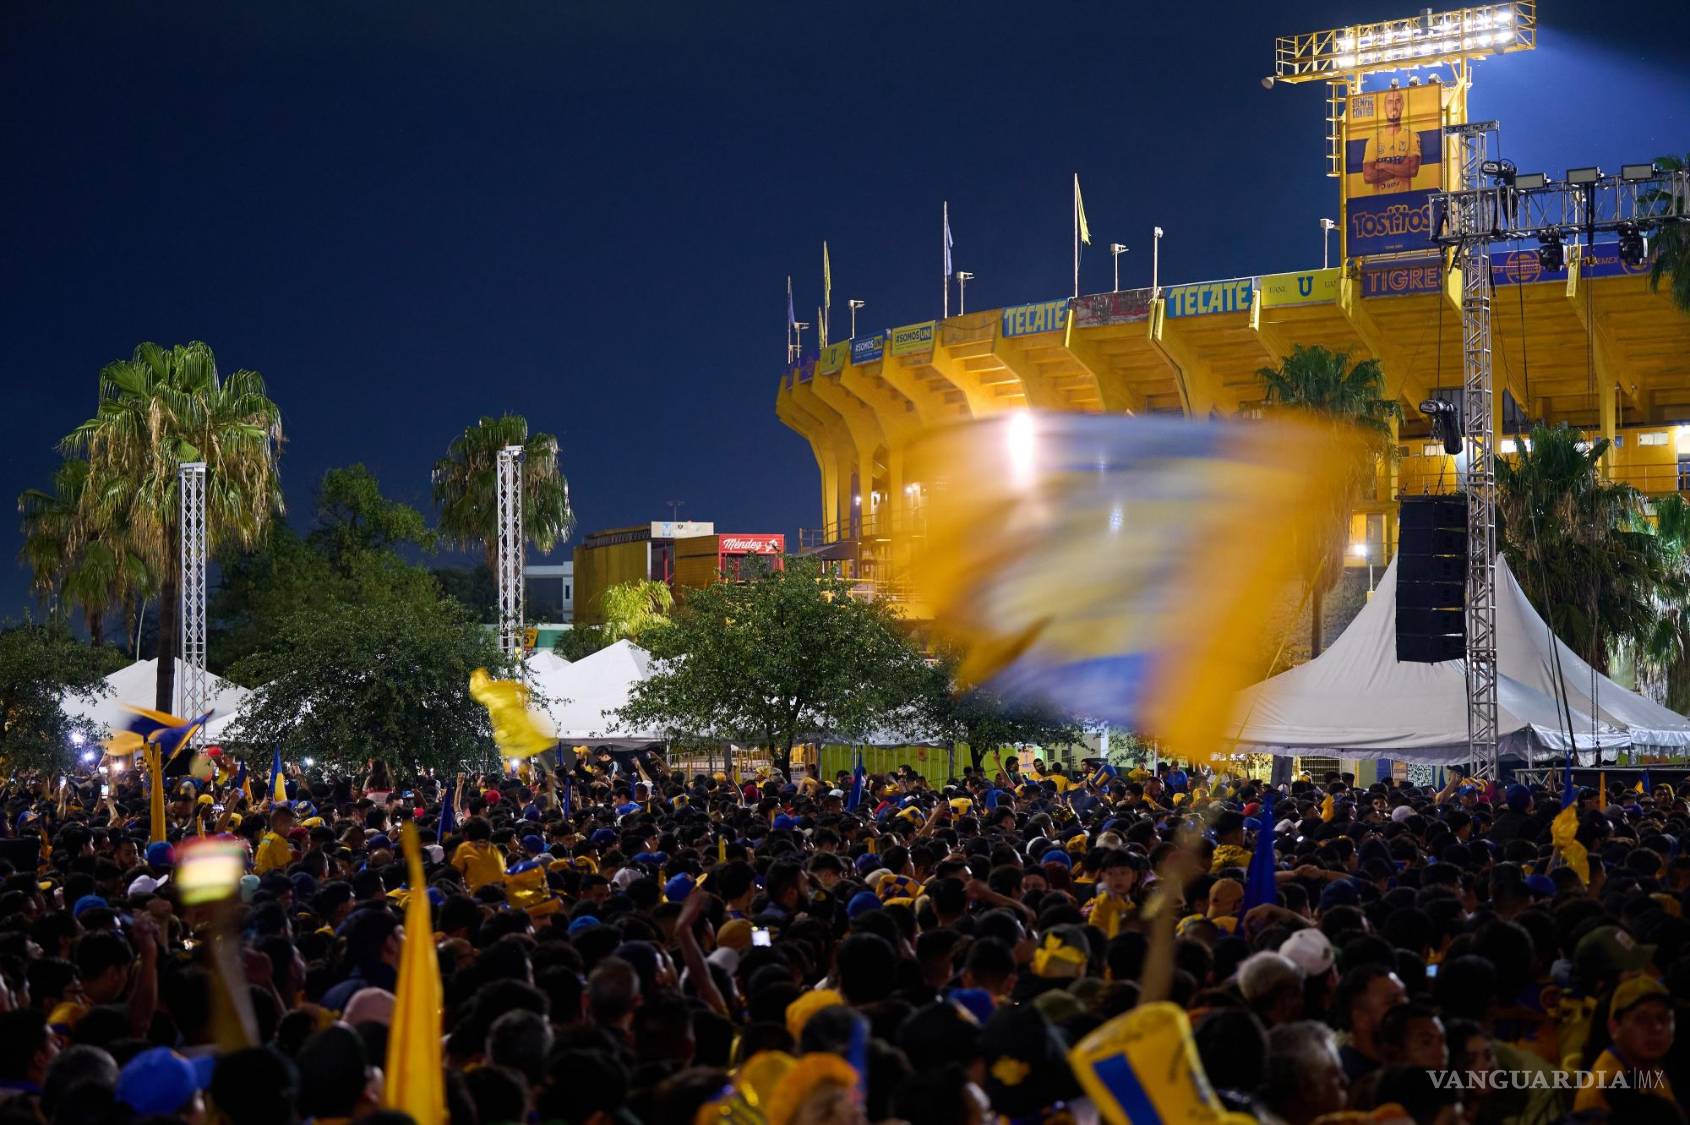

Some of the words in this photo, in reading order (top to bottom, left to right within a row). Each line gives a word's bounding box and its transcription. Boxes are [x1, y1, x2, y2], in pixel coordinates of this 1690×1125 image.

[1368, 266, 1442, 292] TIGRE
[1169, 280, 1251, 316] TECATE
[1003, 300, 1068, 336] TECATE
